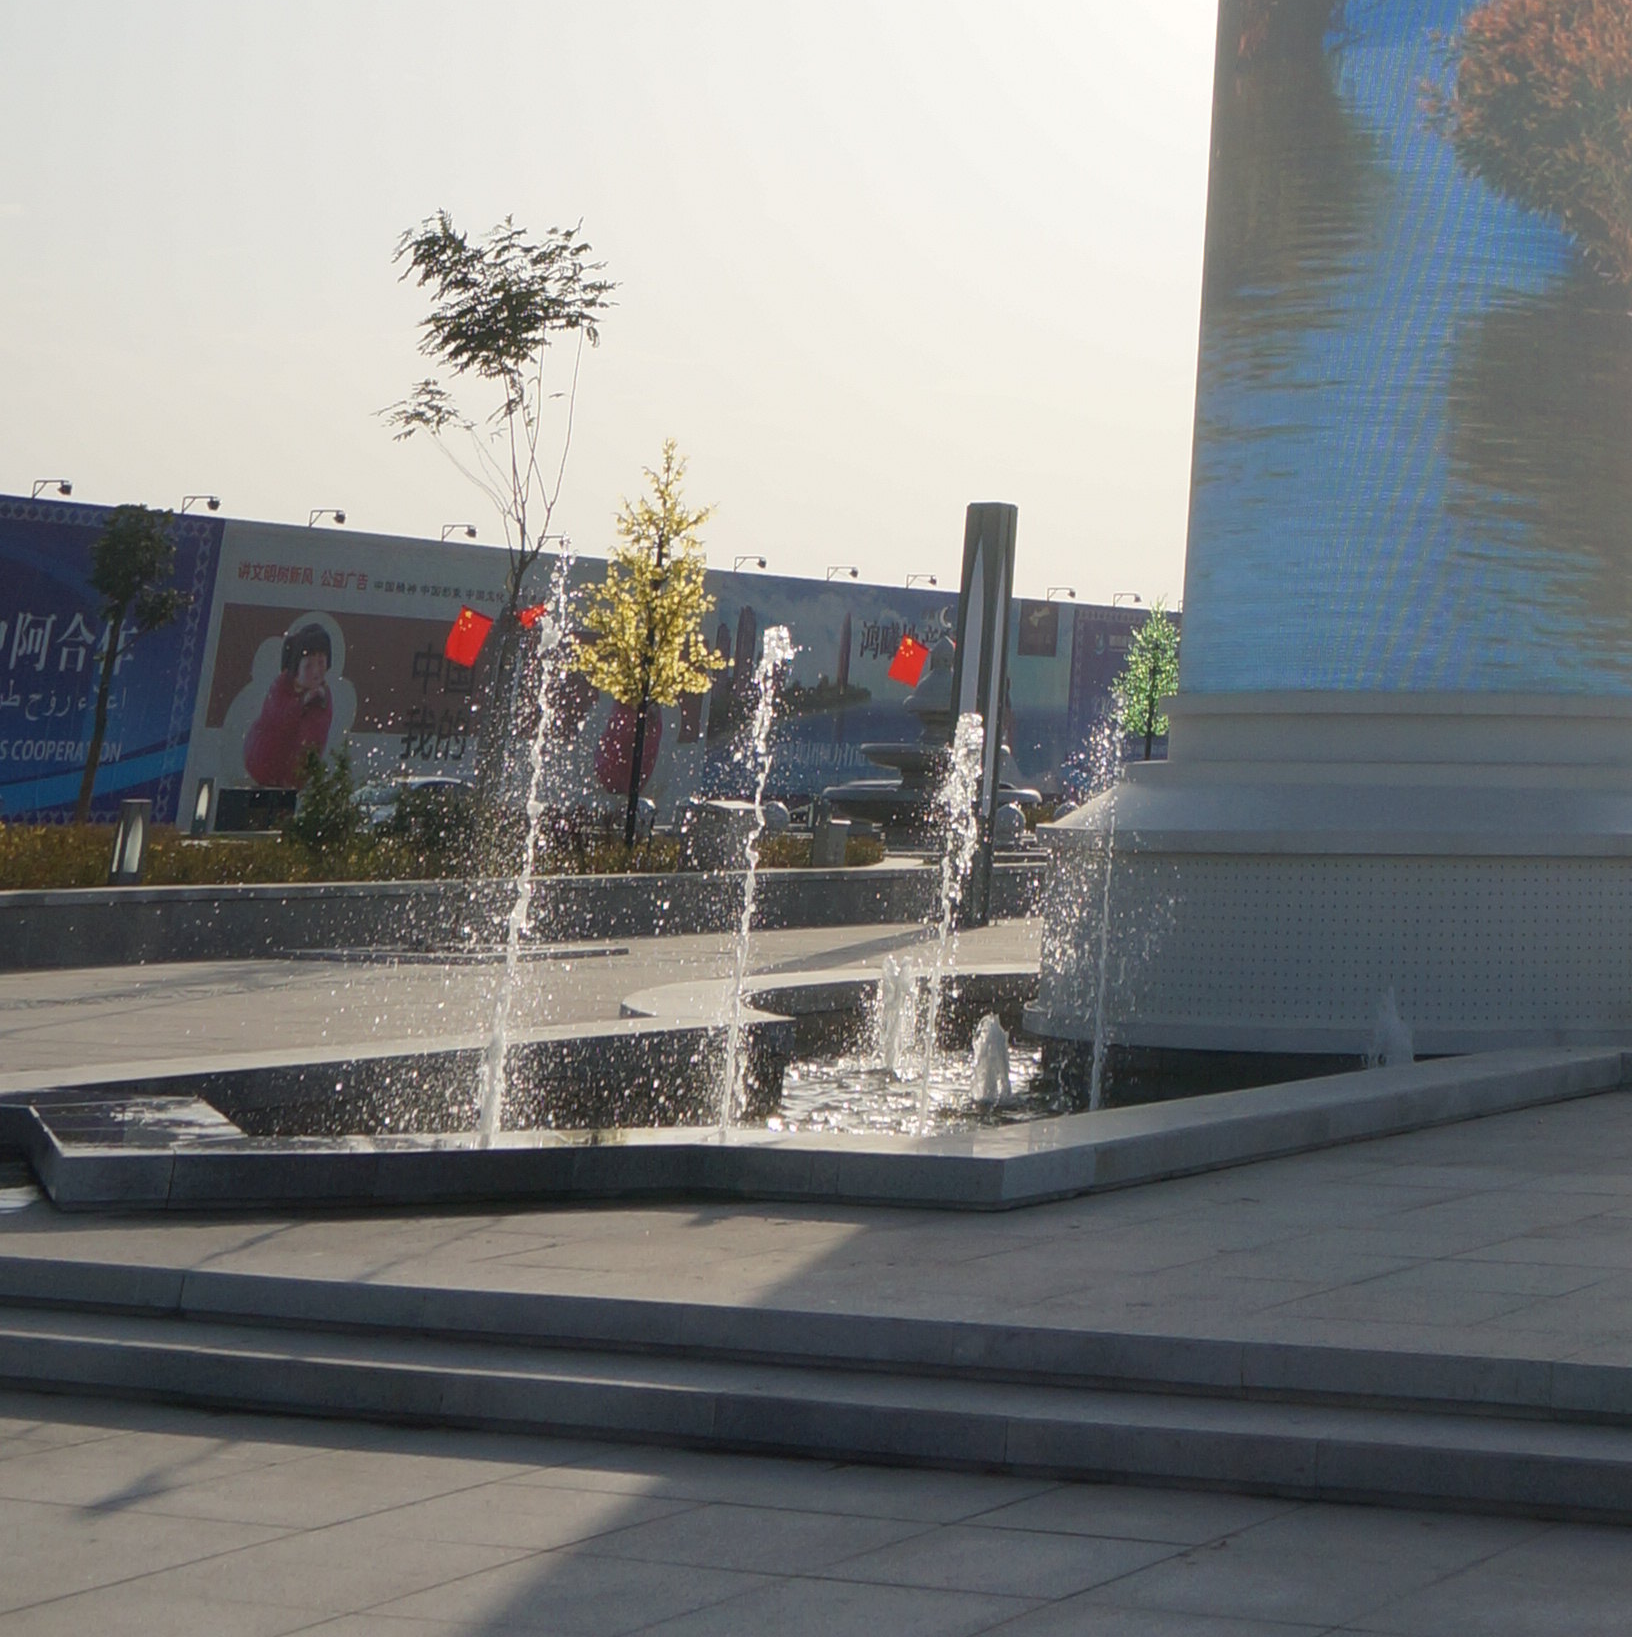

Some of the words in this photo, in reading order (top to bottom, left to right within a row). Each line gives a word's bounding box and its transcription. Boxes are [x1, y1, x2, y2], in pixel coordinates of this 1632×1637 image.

[238, 560, 314, 586] 讲文明树新风
[320, 568, 369, 591] 公益广告
[11, 738, 122, 763] COOPERAON
